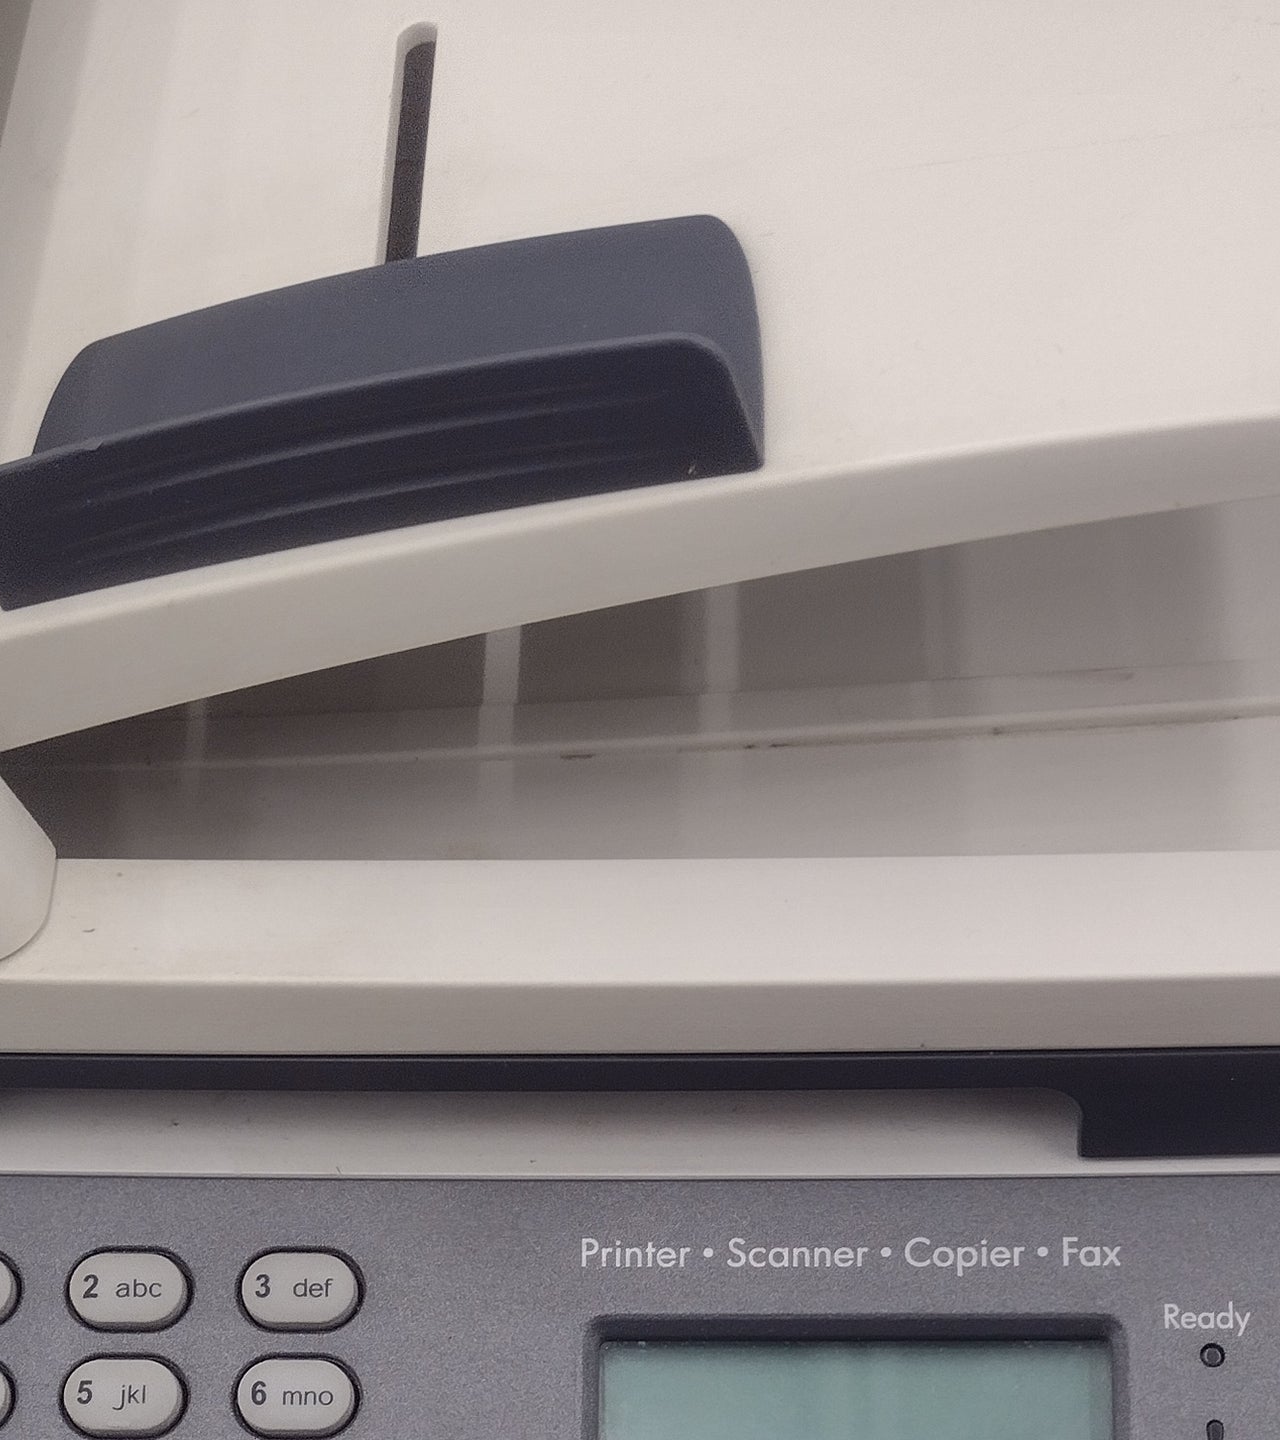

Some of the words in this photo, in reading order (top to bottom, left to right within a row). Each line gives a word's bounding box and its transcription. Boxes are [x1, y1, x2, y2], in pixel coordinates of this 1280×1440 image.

[581, 1237, 691, 1268] Printer
[726, 1237, 869, 1268] Scanner
[904, 1236, 1025, 1277] Copier
[1062, 1236, 1121, 1267] Fax
[82, 1274, 99, 1299] 2
[115, 1278, 162, 1298] abc
[255, 1273, 271, 1299] 3
[292, 1278, 334, 1299] def
[1163, 1300, 1251, 1337] Ready
[76, 1380, 93, 1405] 5
[112, 1384, 146, 1411] jkl
[251, 1380, 267, 1406] 6
[282, 1390, 334, 1406] mno
